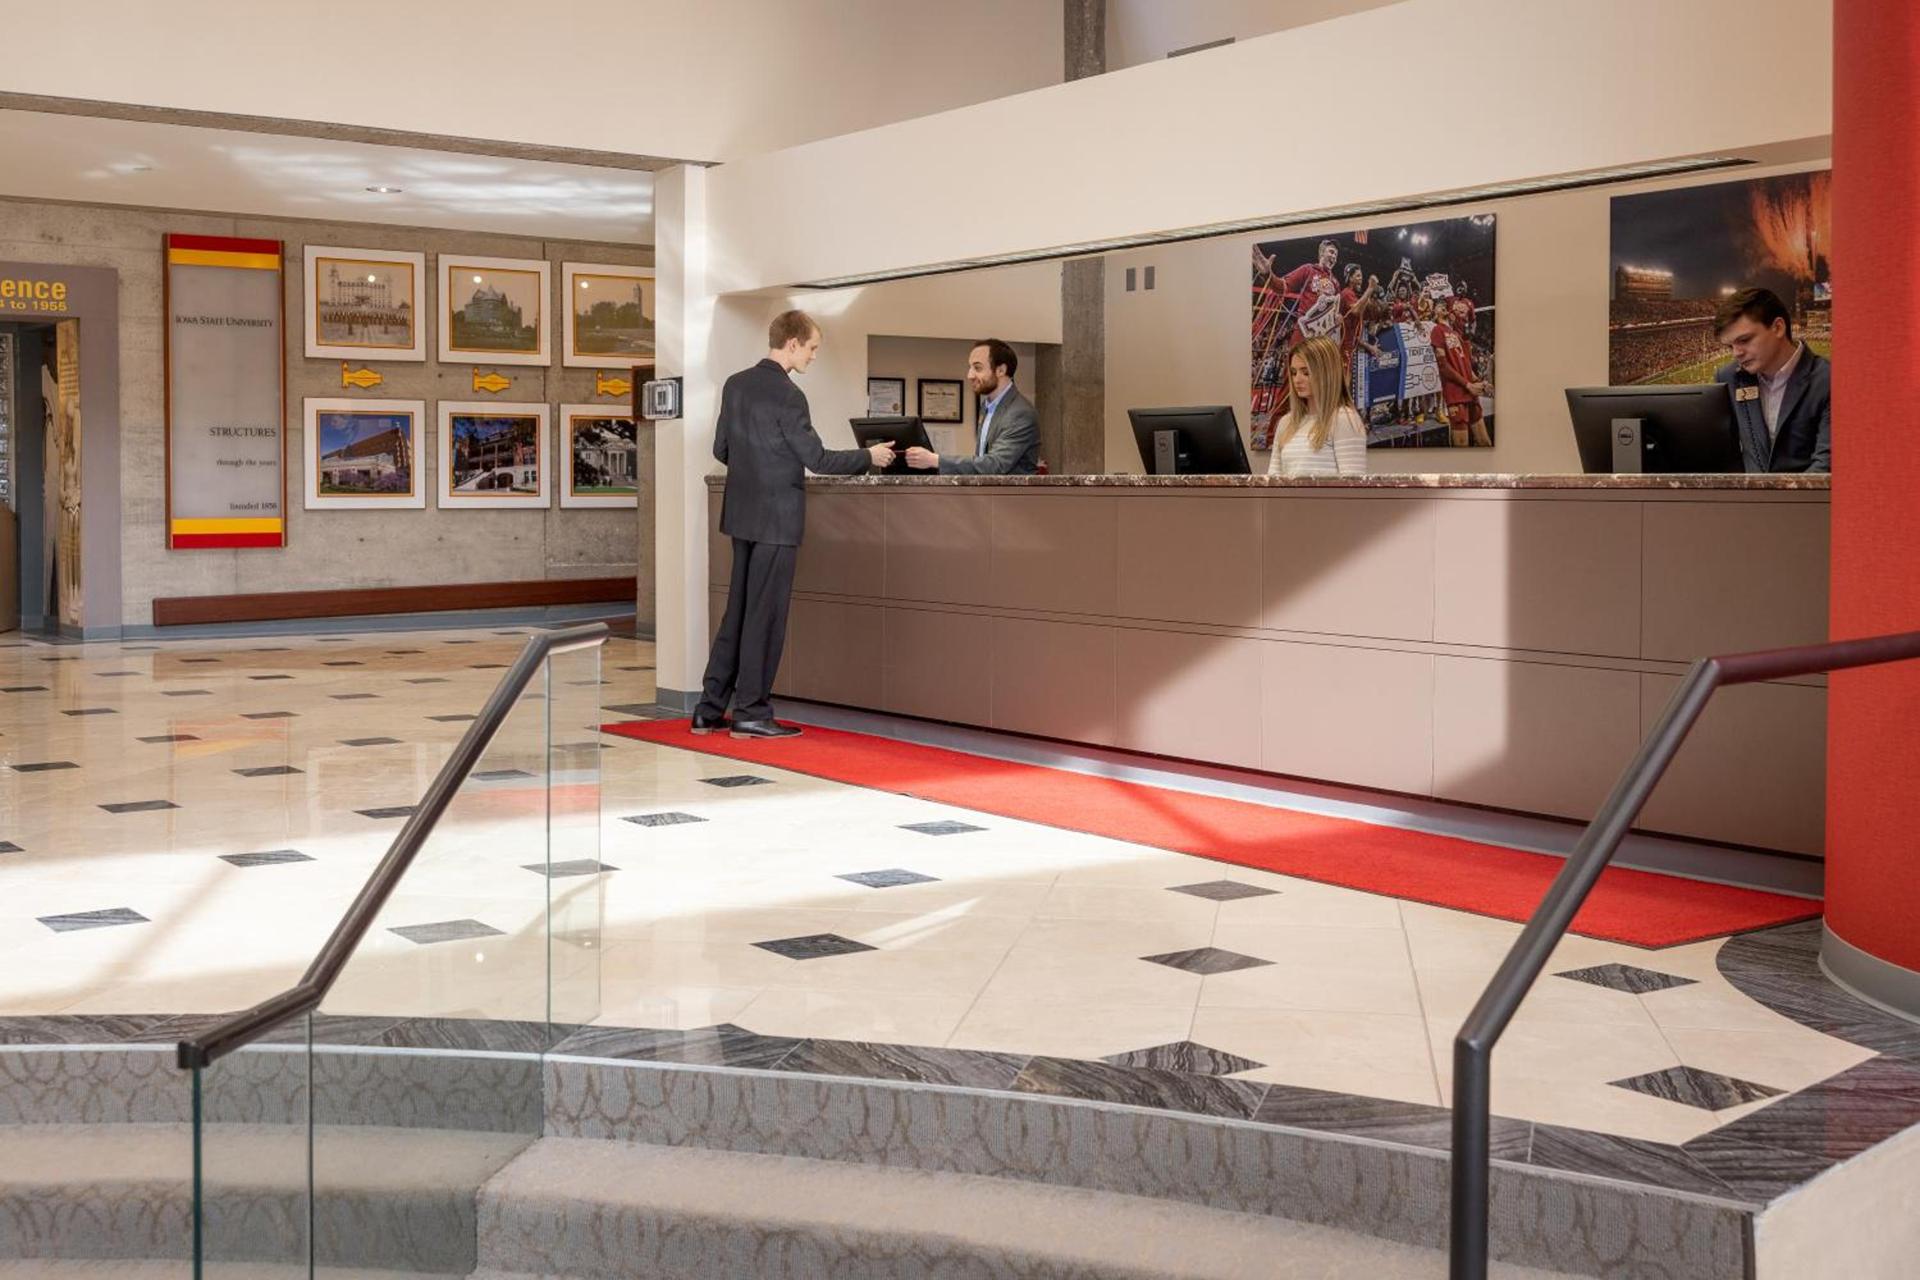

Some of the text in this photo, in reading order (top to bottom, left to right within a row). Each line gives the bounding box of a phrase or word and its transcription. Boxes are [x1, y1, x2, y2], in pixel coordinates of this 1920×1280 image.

[10, 300, 26, 310] to
[31, 301, 67, 311] 1955
[209, 427, 276, 437] STRUCTURES
